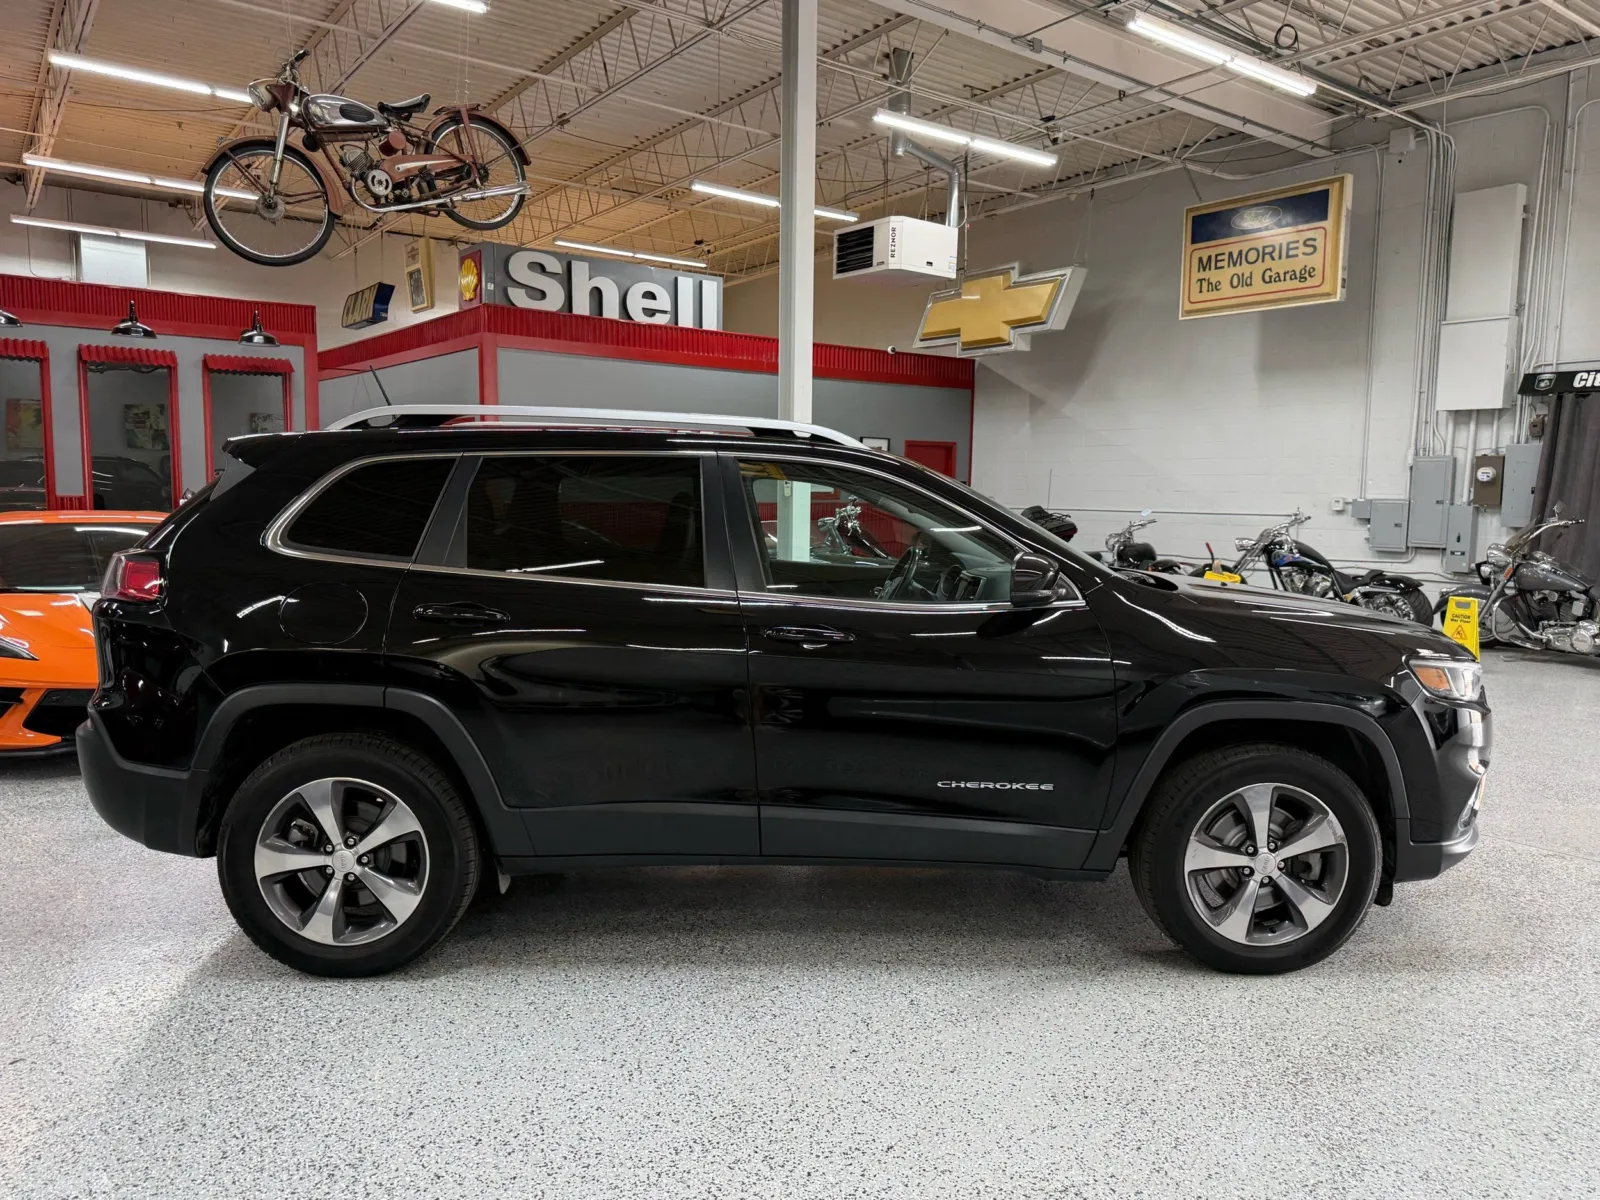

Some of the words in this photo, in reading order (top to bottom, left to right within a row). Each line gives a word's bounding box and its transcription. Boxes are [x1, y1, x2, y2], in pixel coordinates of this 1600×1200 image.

[1240, 209, 1271, 226] Ford
[1197, 237, 1318, 273] MEMORIES
[506, 250, 718, 331] Shell
[1196, 277, 1222, 294] The
[1229, 271, 1253, 289] Old
[1261, 264, 1317, 284] Garage
[936, 780, 1055, 791] CHEROKEE
